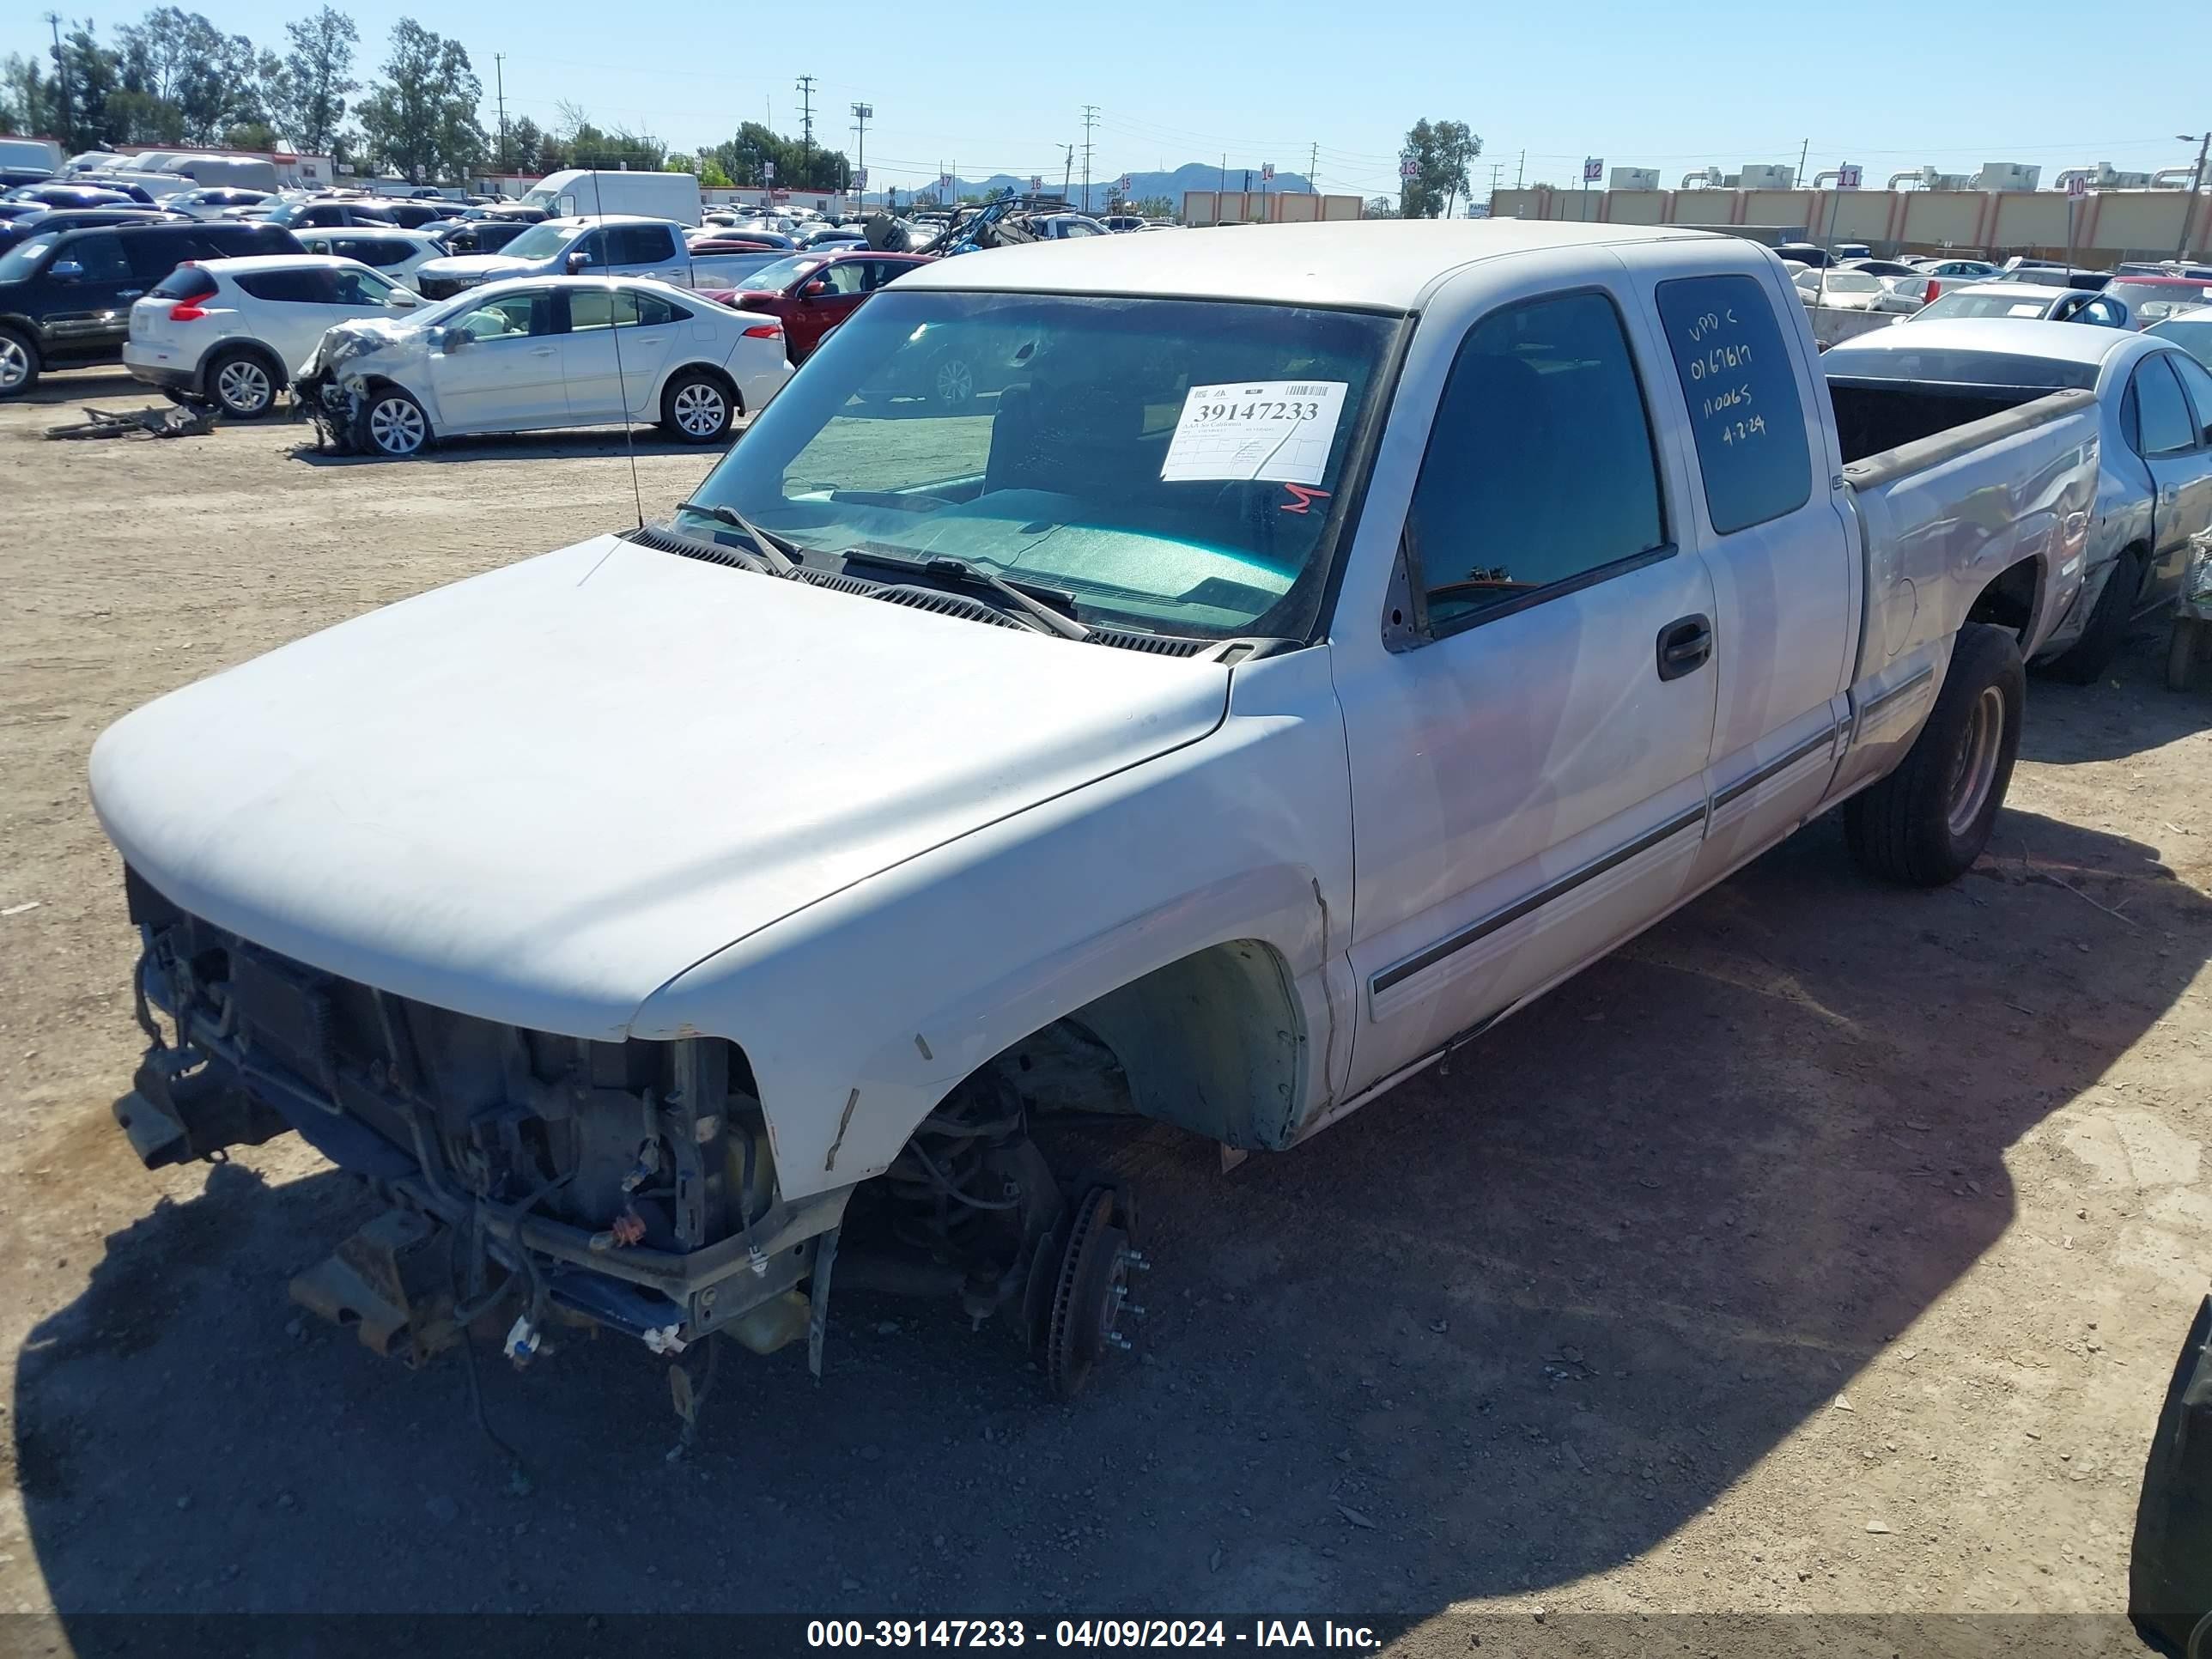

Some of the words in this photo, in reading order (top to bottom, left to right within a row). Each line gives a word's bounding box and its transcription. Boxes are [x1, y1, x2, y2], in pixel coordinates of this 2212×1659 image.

[765, 165, 773, 175] 19
[1262, 167, 1274, 180] 14
[1401, 161, 1417, 176] 13
[1583, 163, 1602, 179] 12
[940, 176, 951, 187] 17
[1031, 179, 1041, 190] 16
[1121, 178, 1131, 190] 15
[1838, 170, 1859, 187] 11
[2069, 178, 2085, 197] 10
[1194, 402, 1319, 423] 39147233
